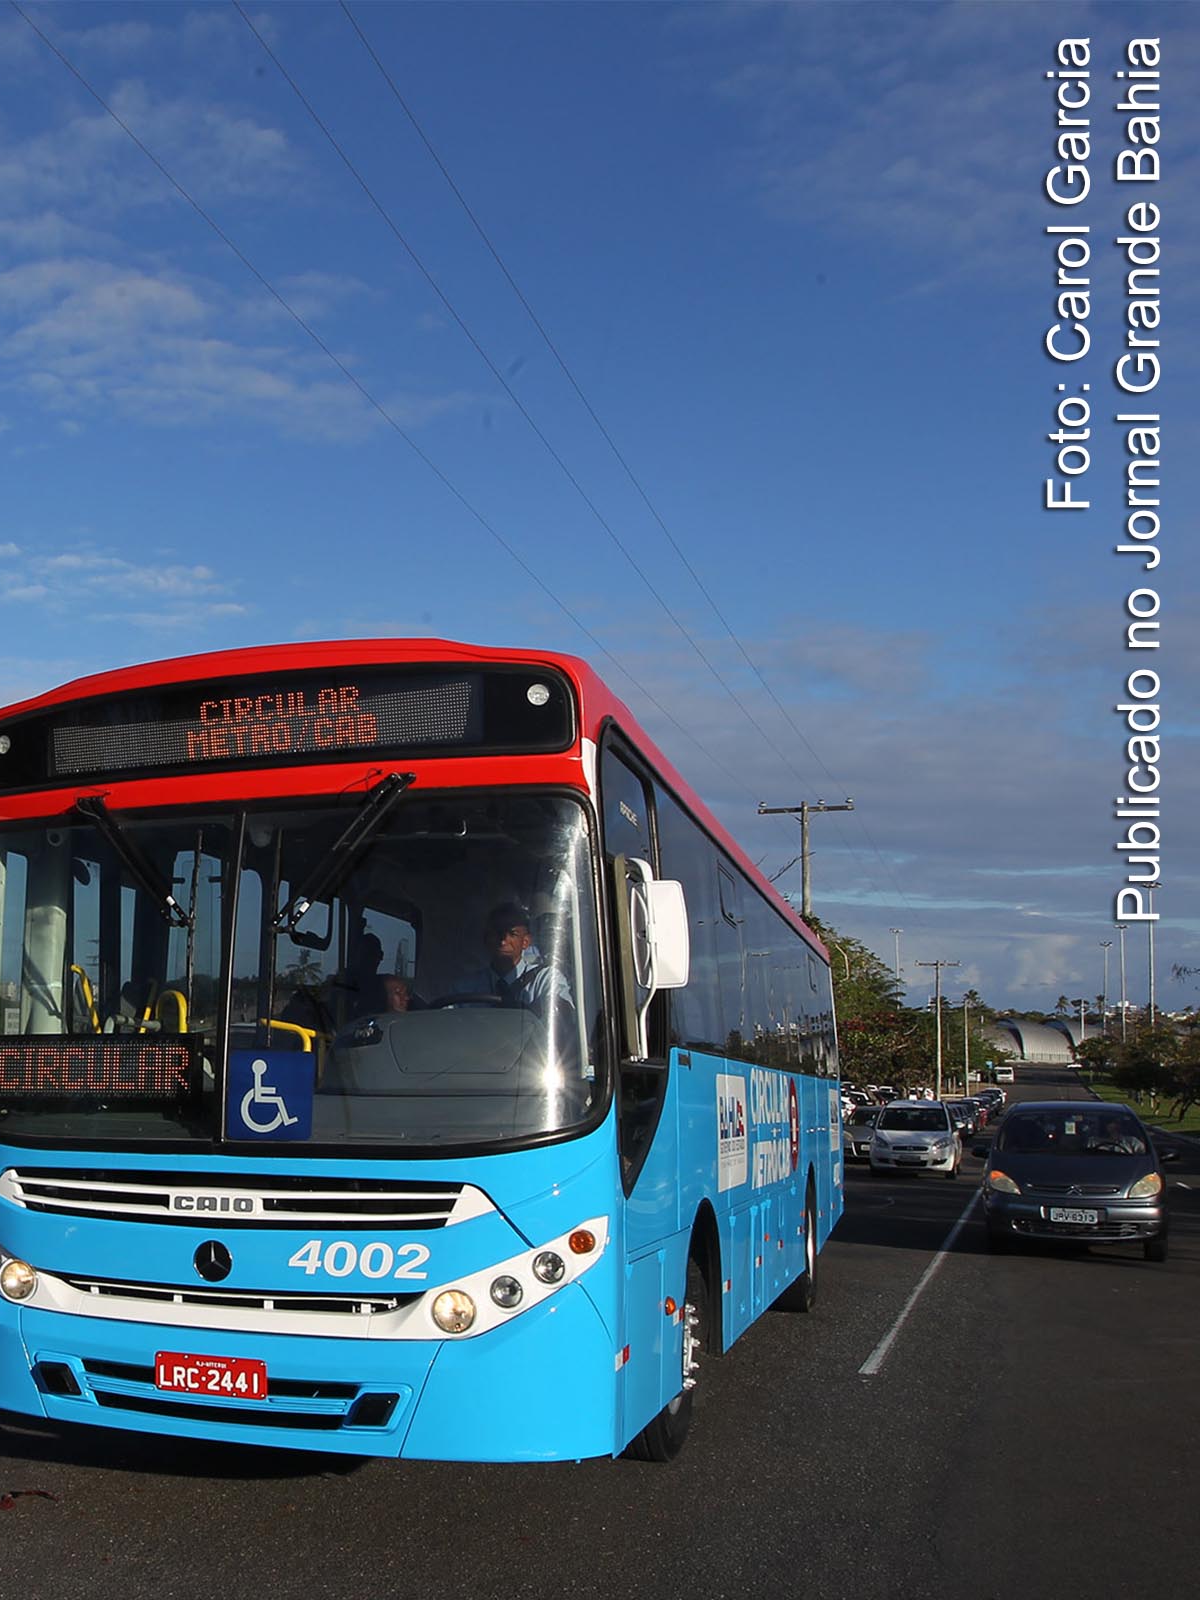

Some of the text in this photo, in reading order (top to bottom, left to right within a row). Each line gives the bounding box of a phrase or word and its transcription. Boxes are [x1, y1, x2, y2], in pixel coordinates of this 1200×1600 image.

[200, 686, 360, 726] CIRCULAR
[186, 713, 377, 759] METRO/CAB
[0, 1047, 190, 1090] CIRCULAR
[174, 1196, 253, 1213] CAIO
[288, 1239, 431, 1280] 4002
